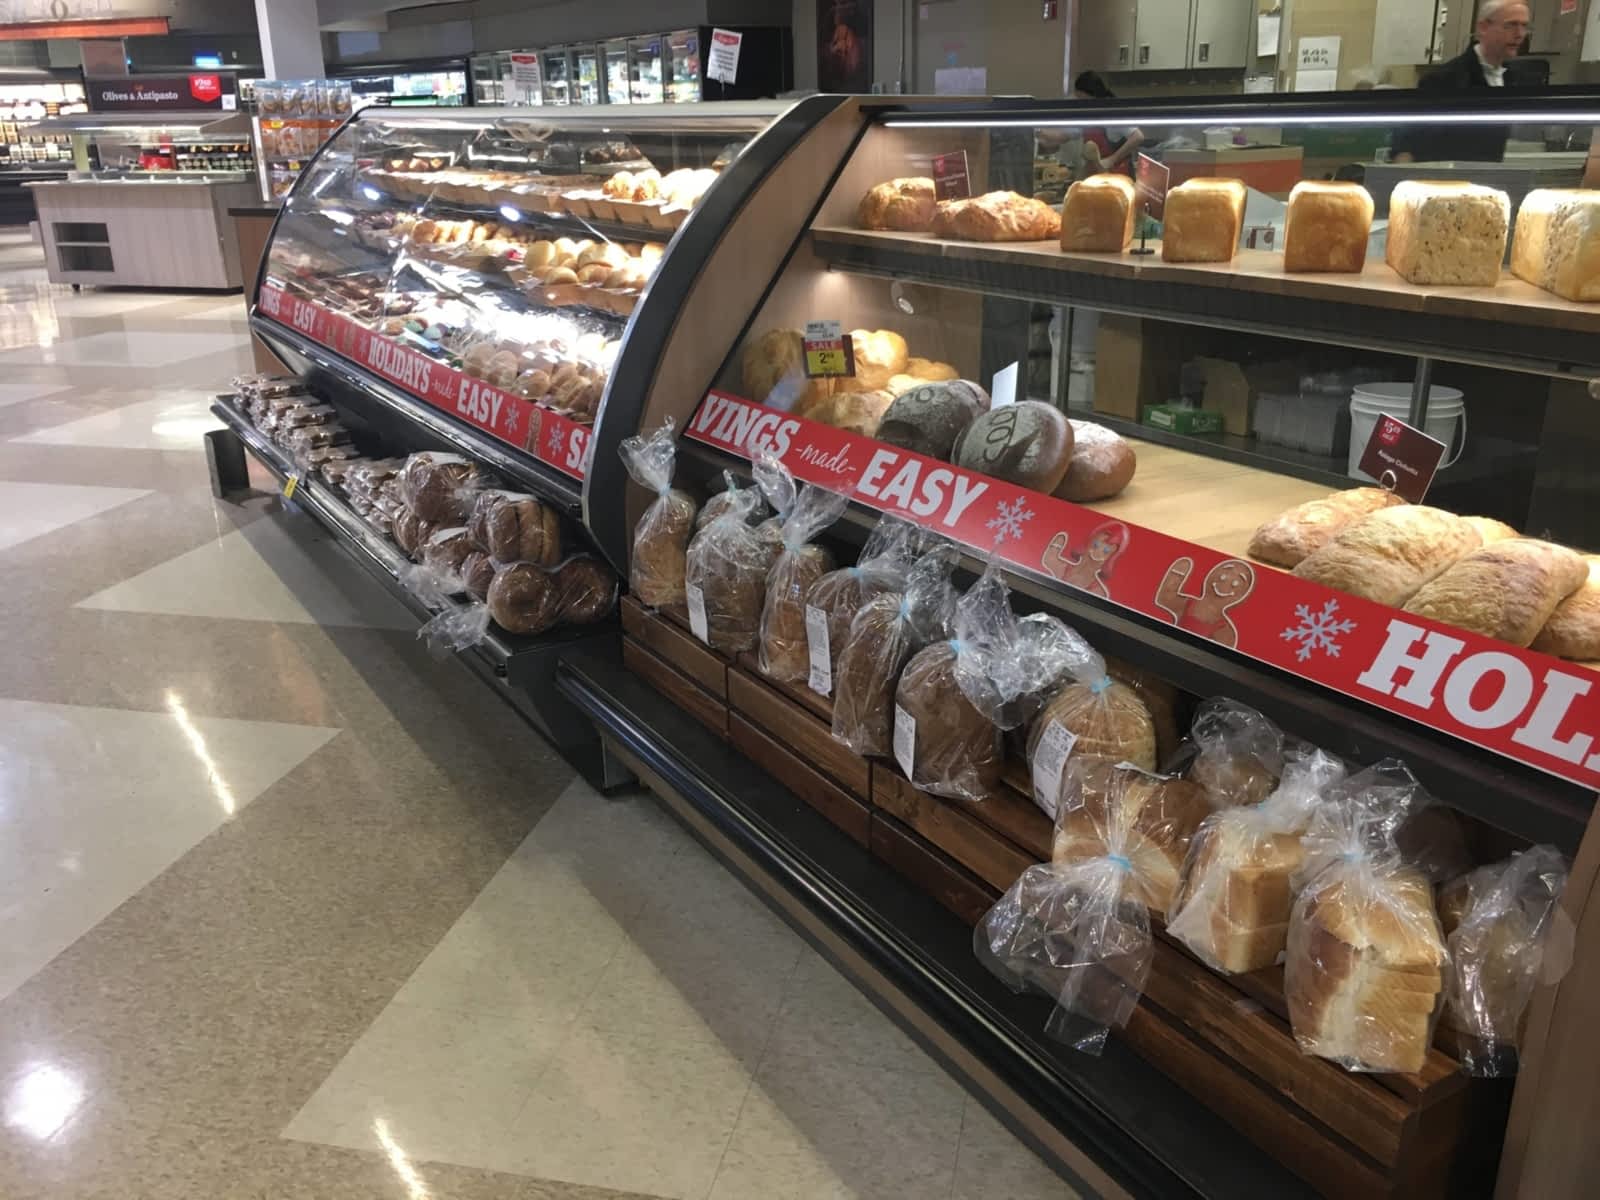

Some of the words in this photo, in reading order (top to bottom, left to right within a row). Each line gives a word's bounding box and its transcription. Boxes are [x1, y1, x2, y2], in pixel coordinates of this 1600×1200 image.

[102, 91, 128, 101] Olives
[137, 91, 178, 102] Antipasto
[294, 300, 316, 333] EASY
[368, 335, 432, 394] HOLIDAYS
[457, 378, 504, 428] EASY
[856, 448, 989, 528] EASY
[1356, 618, 1600, 774] HOL
